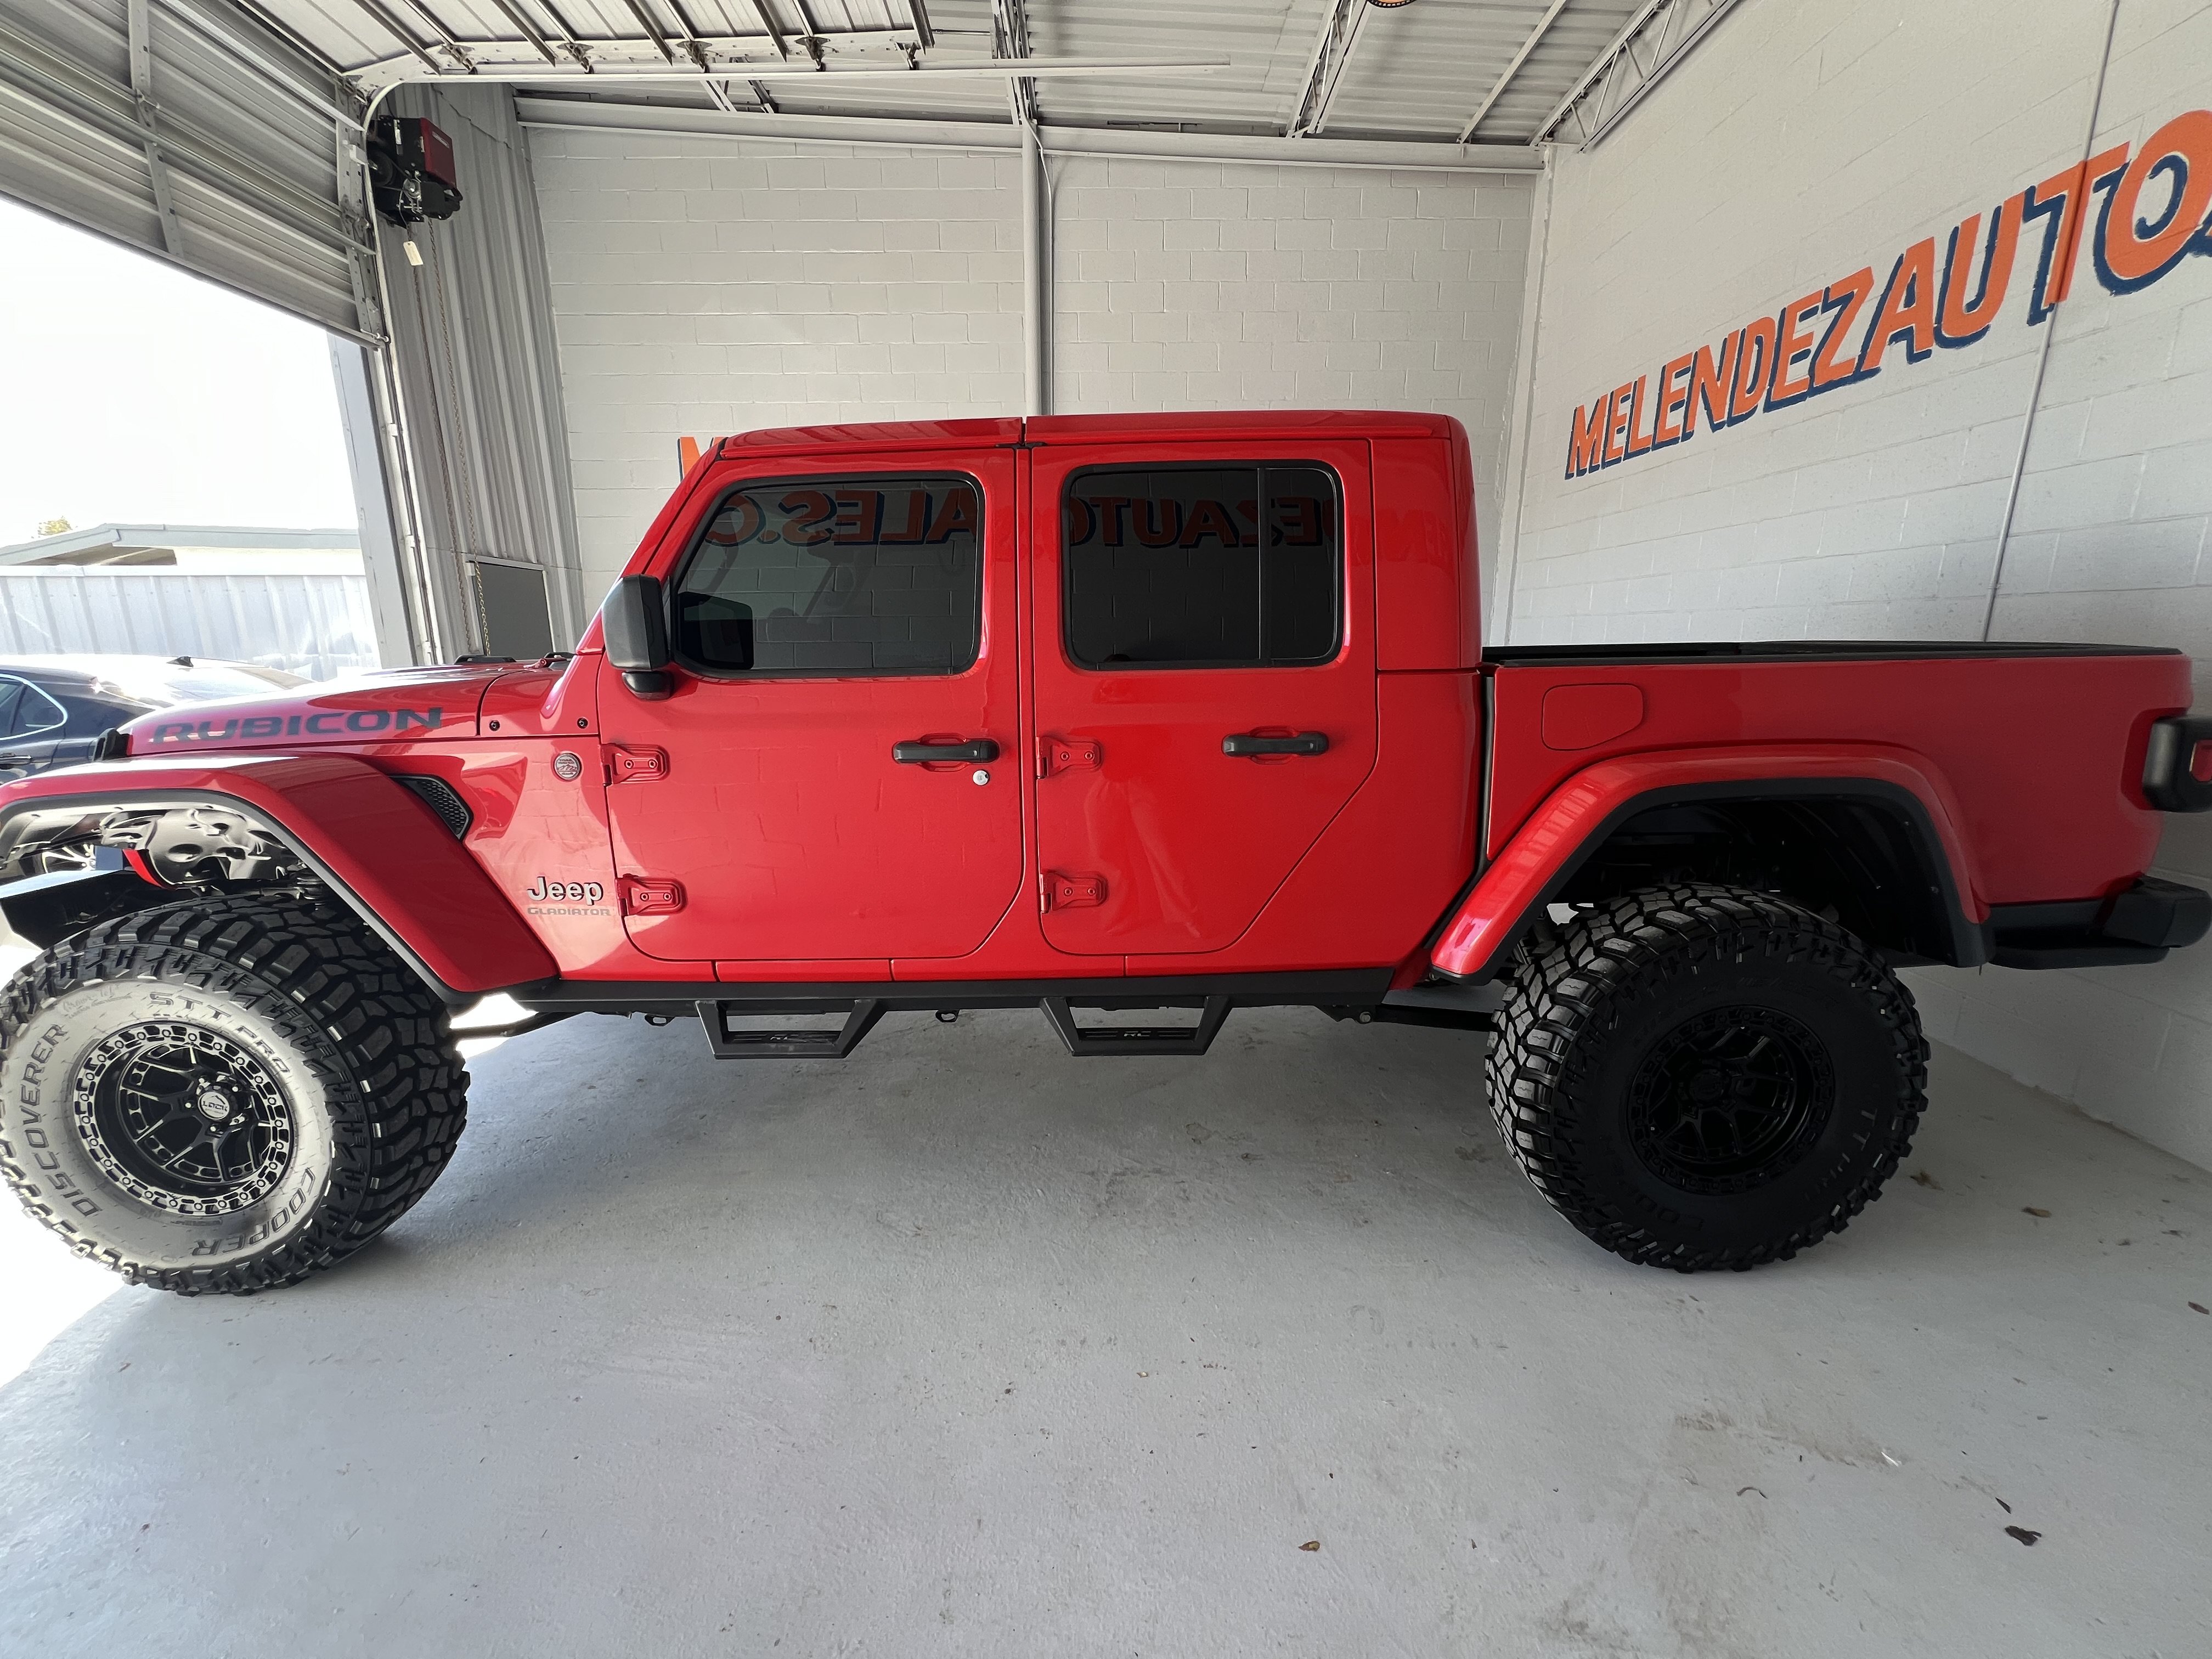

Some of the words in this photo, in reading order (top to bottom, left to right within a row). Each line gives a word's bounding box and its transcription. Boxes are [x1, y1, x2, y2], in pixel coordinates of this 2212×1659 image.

[1565, 110, 2212, 480] MELENDEZAUTO
[148, 707, 442, 744] RUBICON
[527, 876, 603, 905] Jeep
[527, 907, 611, 916] GLADIATOR
[149, 991, 231, 1019] STT
[19, 1024, 103, 1216] DISCOVERER
[192, 1167, 315, 1256] COOPER
